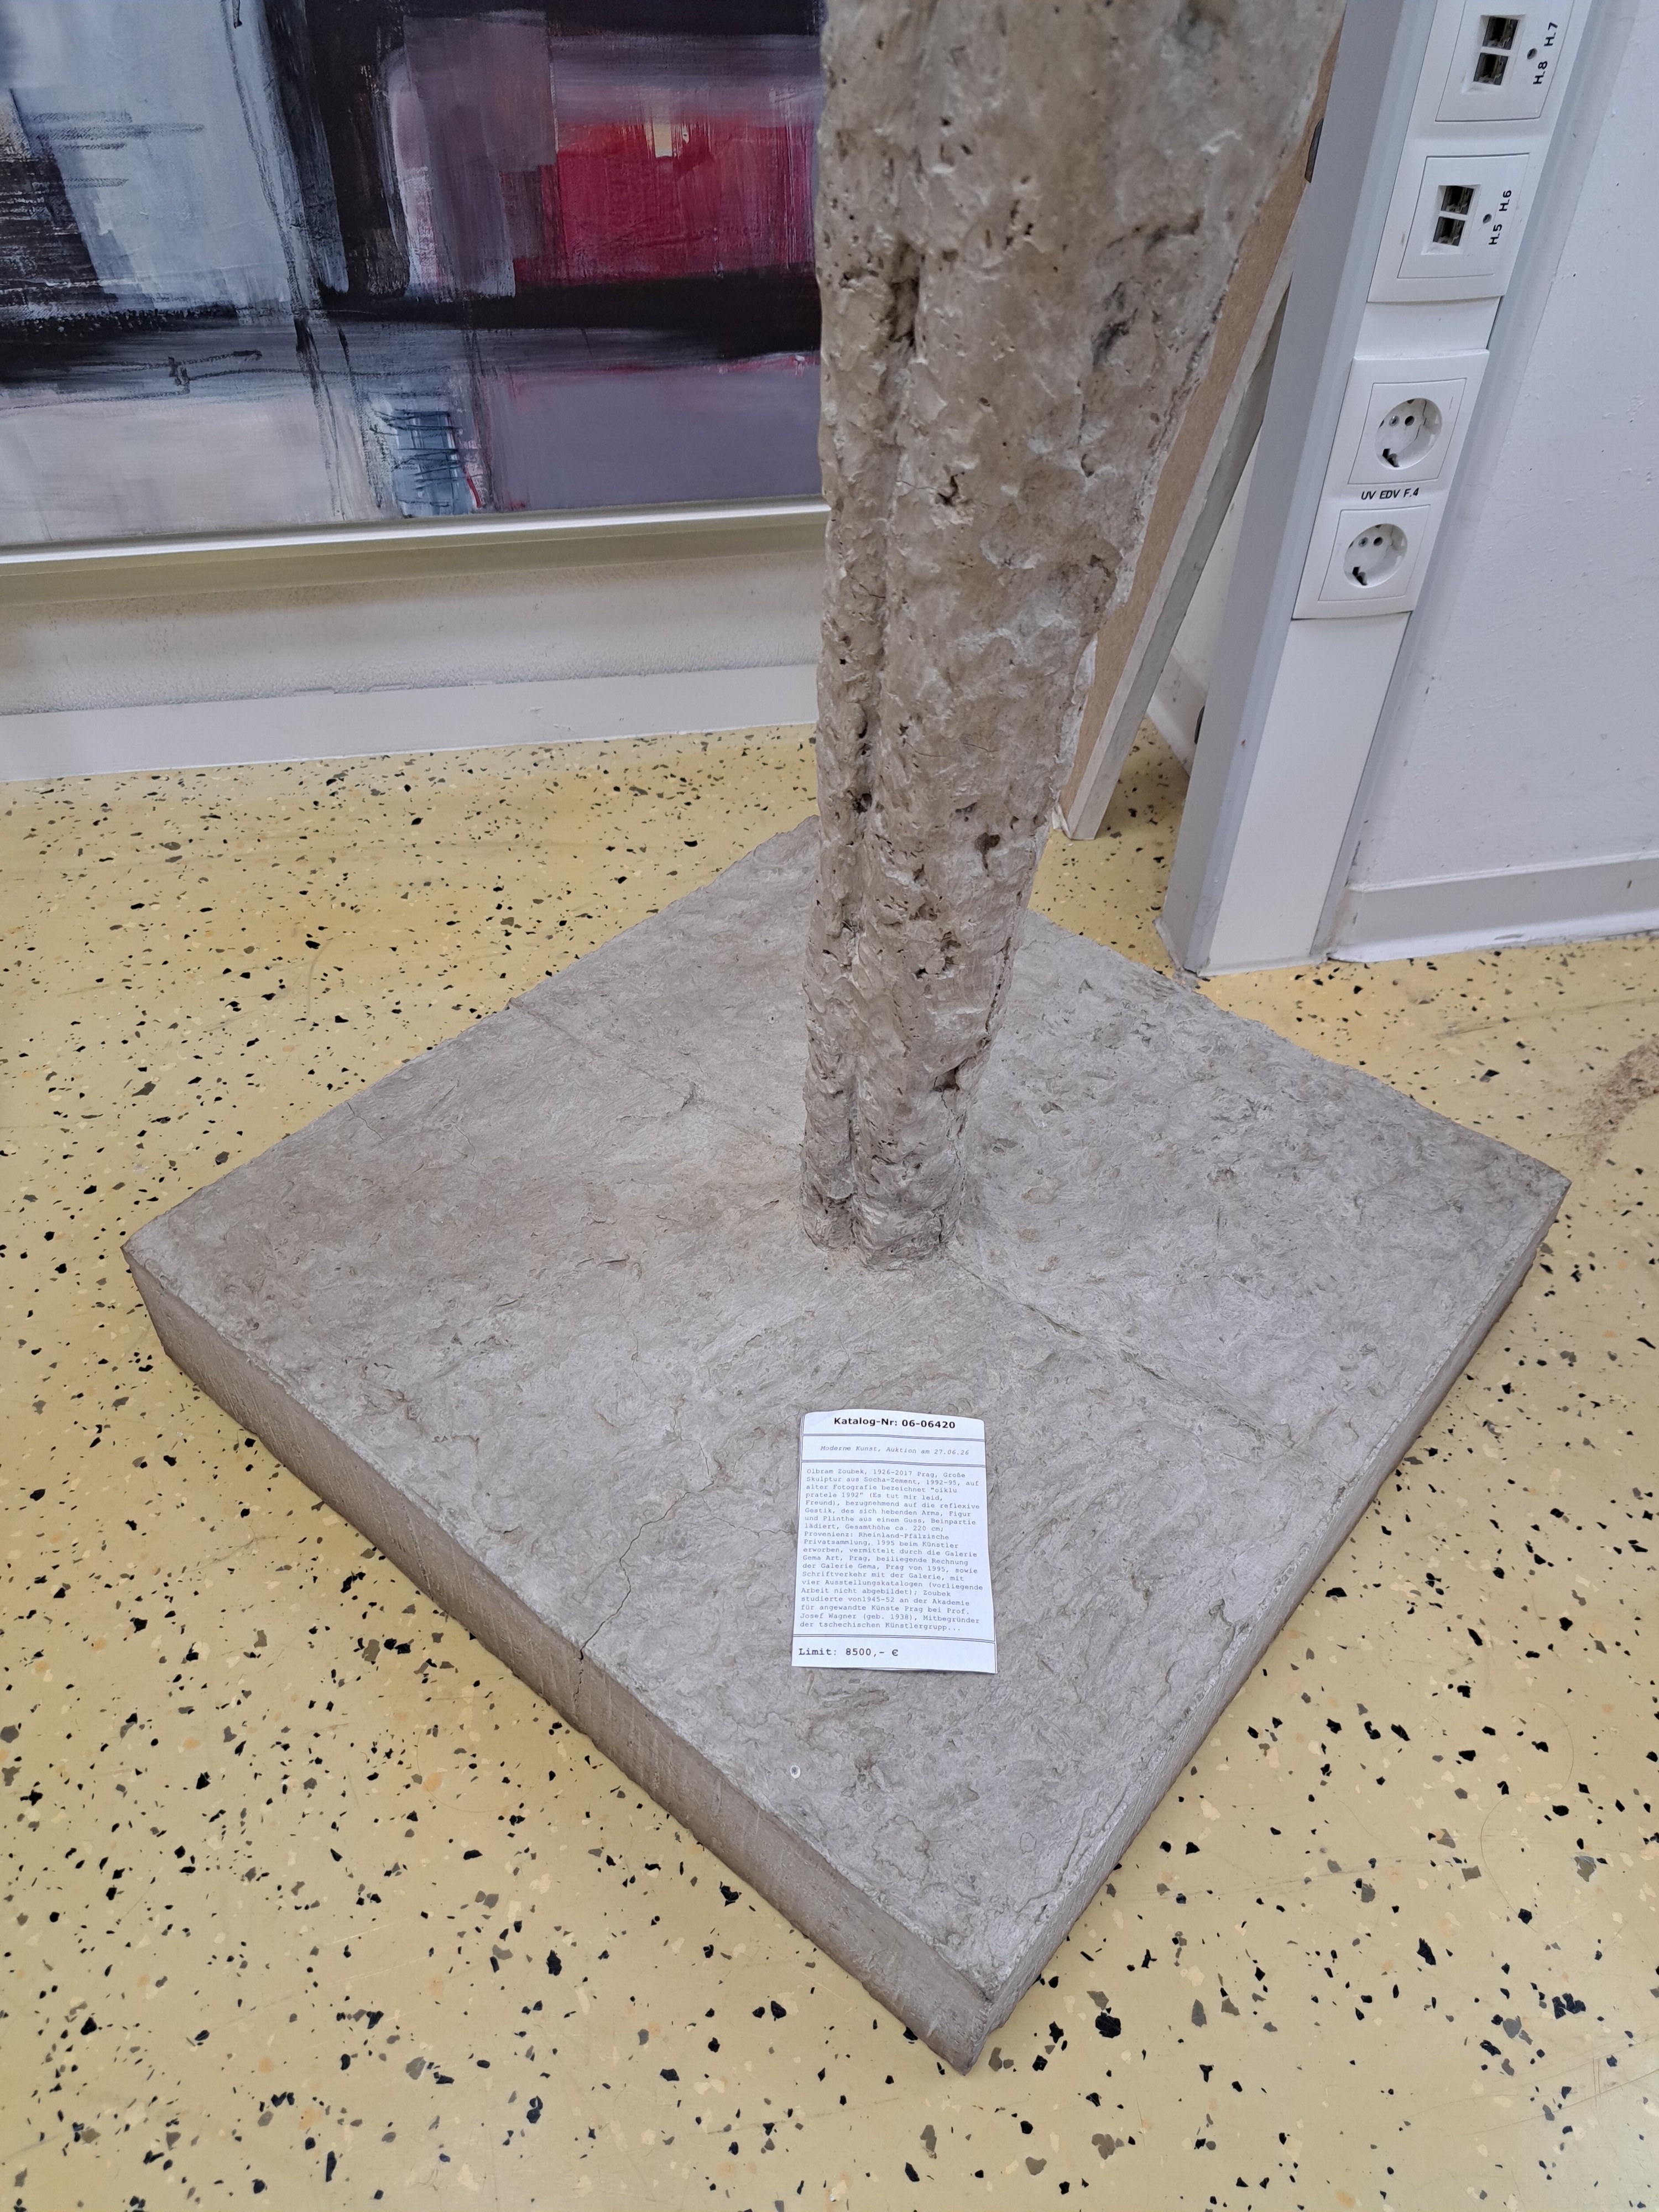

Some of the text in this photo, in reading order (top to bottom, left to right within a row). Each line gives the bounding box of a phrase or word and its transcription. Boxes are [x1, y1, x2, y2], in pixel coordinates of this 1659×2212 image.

[1361, 488, 1419, 500] UV EDV F.4
[834, 1417, 955, 1428] Katalog-Nr: 06-06420
[825, 1579, 922, 1588] Ausstellungskatalogen
[930, 1582, 983, 1590] (vorliegende
[846, 1648, 884, 1657] 8500,-
